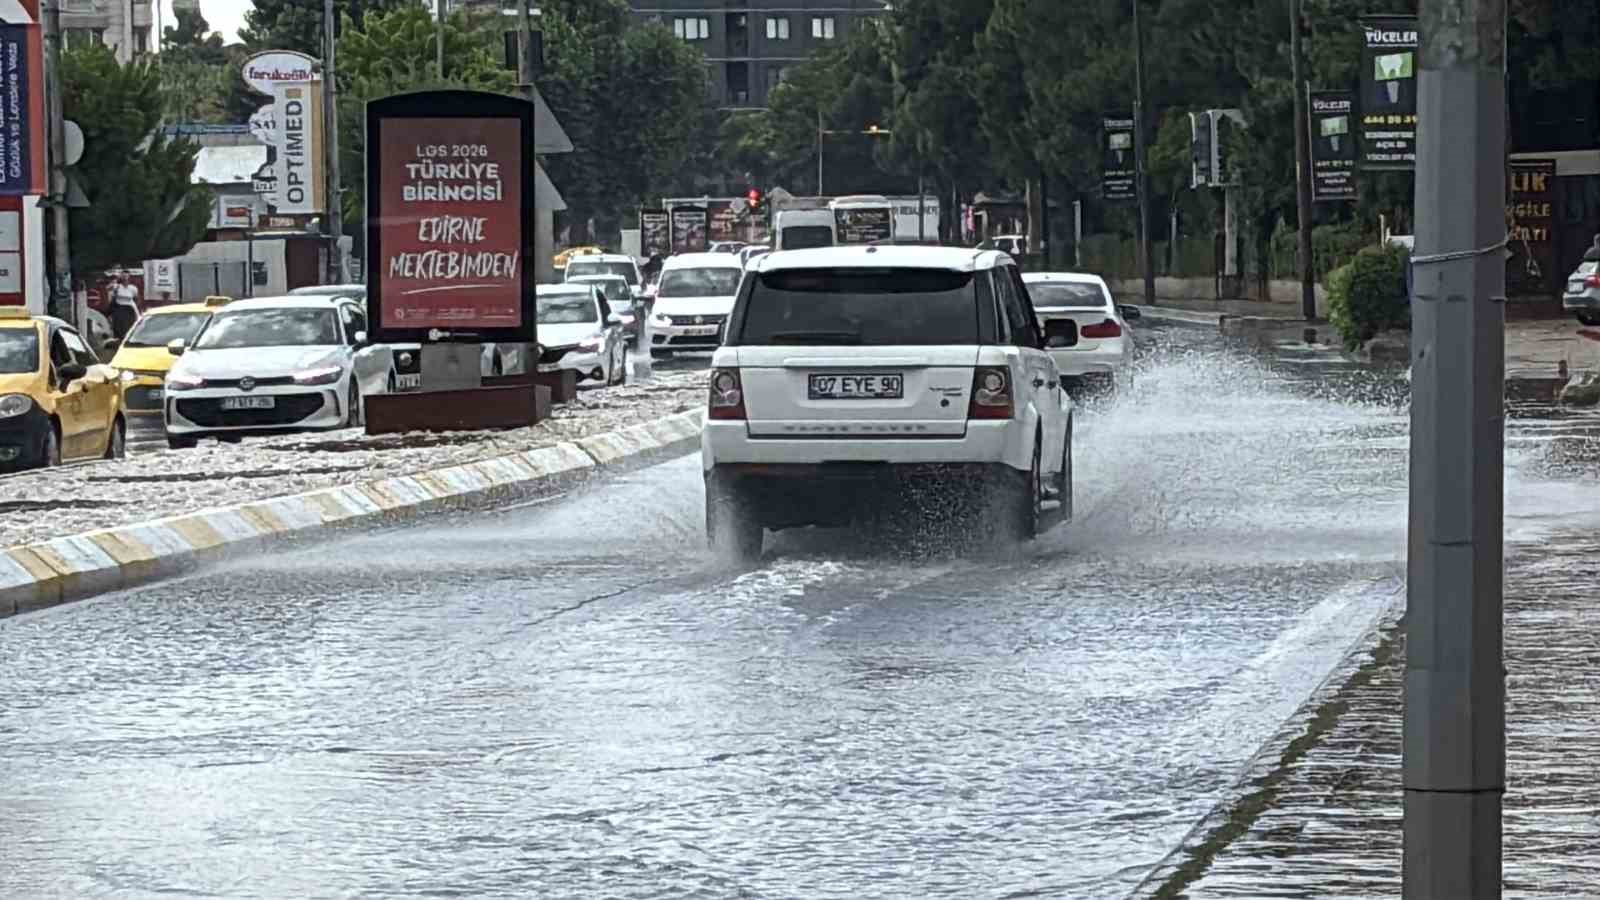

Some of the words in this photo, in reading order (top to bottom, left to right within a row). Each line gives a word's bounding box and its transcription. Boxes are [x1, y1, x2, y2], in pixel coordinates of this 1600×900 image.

[1365, 29, 1418, 43] YÜCELER
[416, 144, 447, 157] LGS
[452, 144, 488, 157] 2026
[405, 159, 499, 179] TÜRKİYE
[403, 180, 502, 201] BİRİNCİSİ
[418, 215, 488, 244] EDİRNE
[389, 248, 519, 279] MEKTEBİMDEN
[818, 376, 836, 393] 07
[841, 376, 876, 392] EYE
[881, 377, 900, 393] 90
